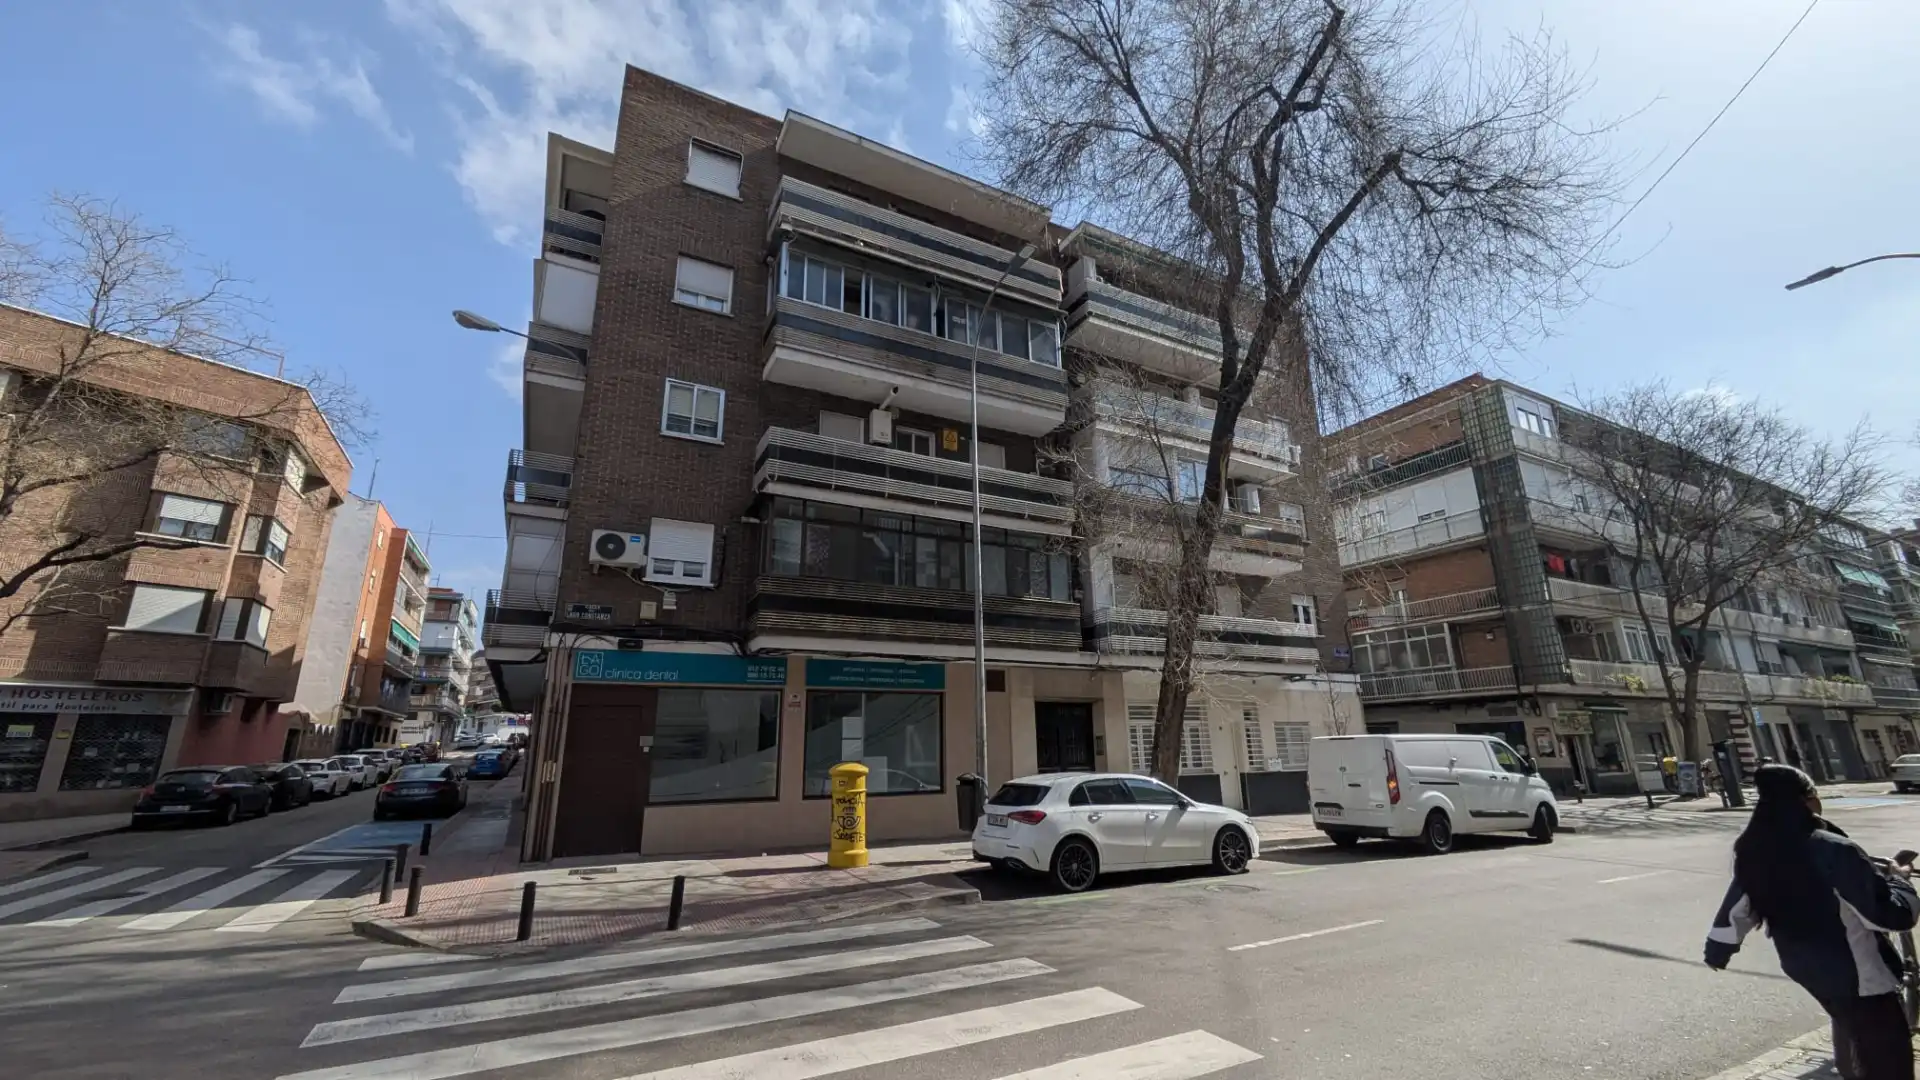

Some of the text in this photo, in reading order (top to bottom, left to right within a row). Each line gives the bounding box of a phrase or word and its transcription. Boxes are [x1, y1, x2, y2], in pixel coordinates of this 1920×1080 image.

[643, 669, 679, 681] dental
[11, 687, 145, 703] HOSTELEROS
[21, 703, 49, 711] para
